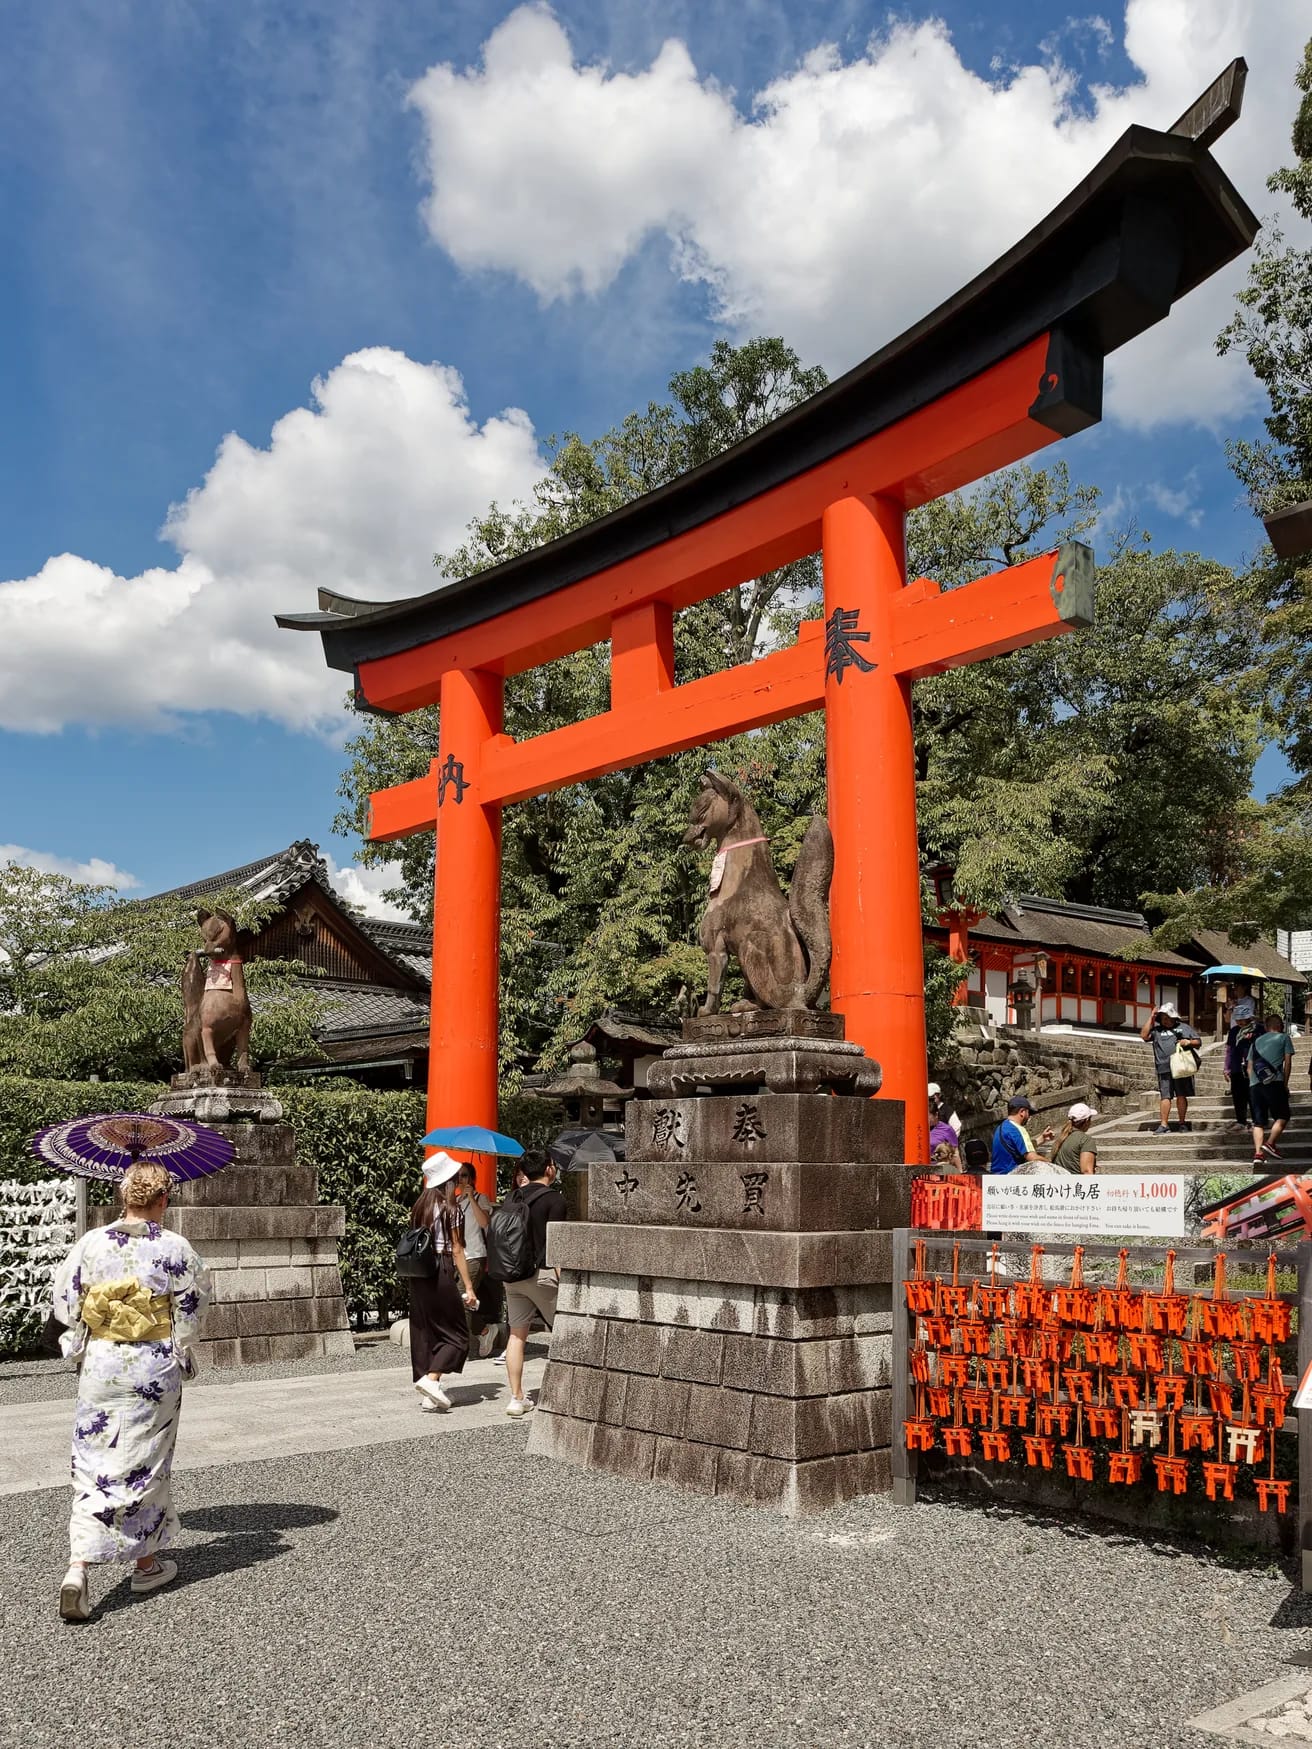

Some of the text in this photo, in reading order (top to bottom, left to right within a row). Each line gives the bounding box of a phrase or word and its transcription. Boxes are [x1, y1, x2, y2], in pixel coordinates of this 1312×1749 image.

[824, 607, 878, 688] 奉
[1032, 1182, 1100, 1200] 願かけ鳥居
